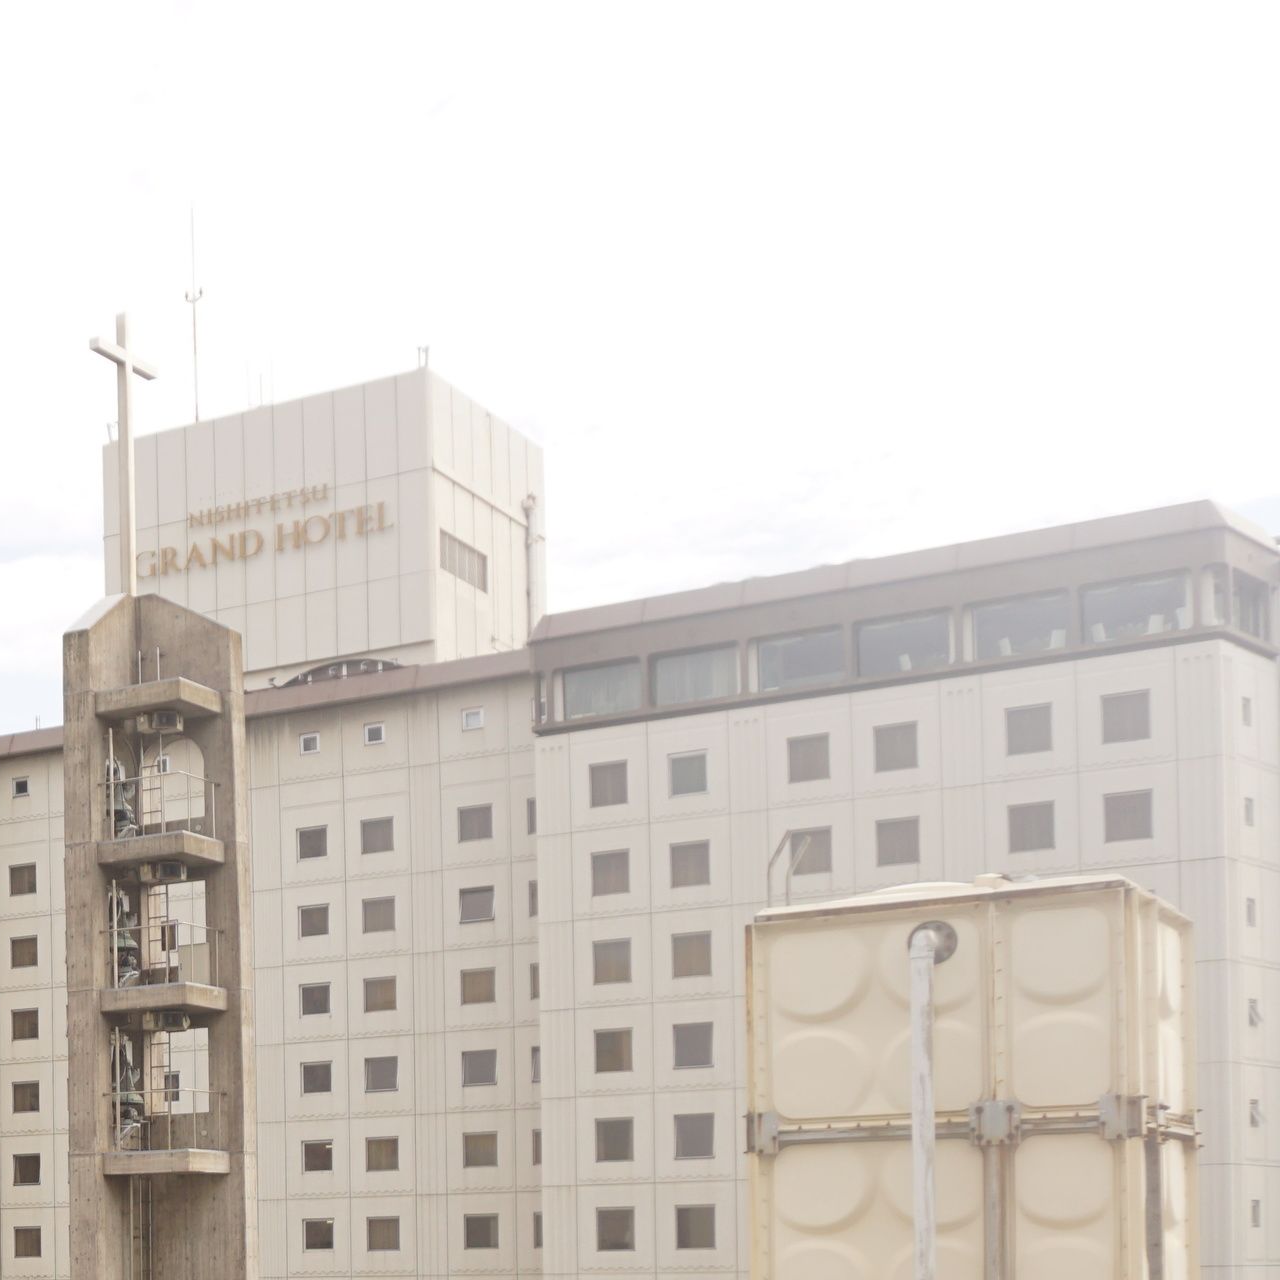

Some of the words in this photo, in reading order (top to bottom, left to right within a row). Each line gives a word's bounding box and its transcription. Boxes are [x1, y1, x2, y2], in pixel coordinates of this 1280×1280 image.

[188, 482, 328, 529] NISHITETSU
[135, 528, 264, 580] GRAND
[274, 500, 395, 554] HOTEL
